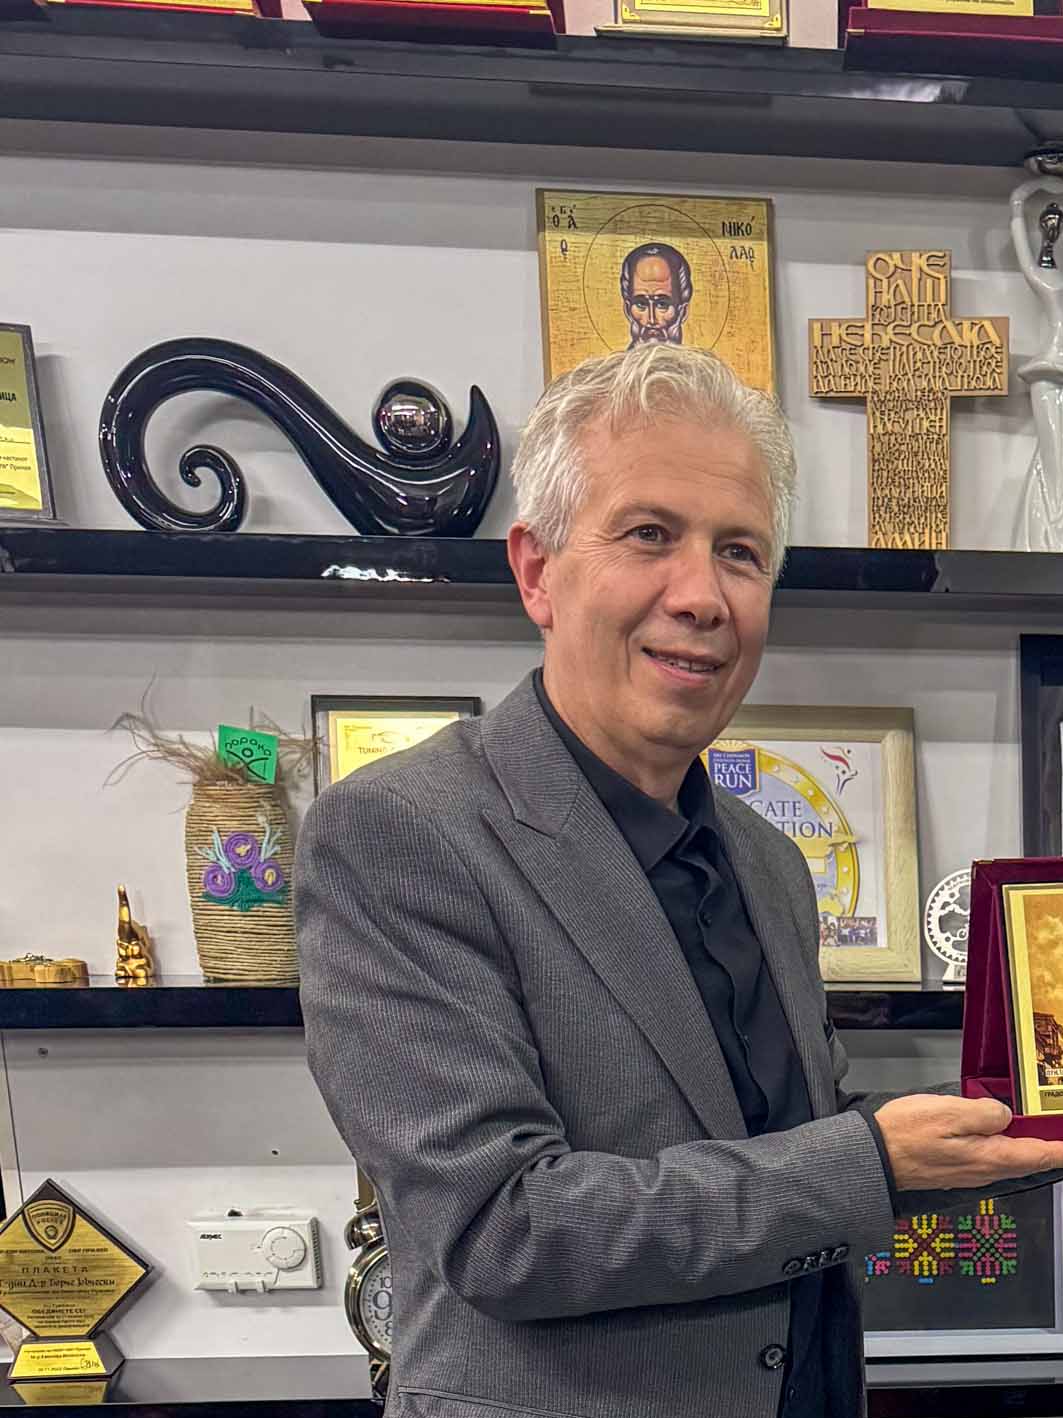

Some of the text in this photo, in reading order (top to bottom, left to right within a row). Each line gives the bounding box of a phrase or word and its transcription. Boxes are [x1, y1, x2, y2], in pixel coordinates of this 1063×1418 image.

[224, 736, 272, 757] порака
[714, 763, 753, 774] PEACE
[714, 774, 753, 789] RUN
[21, 1266, 89, 1275] ПЛАКЕТА
